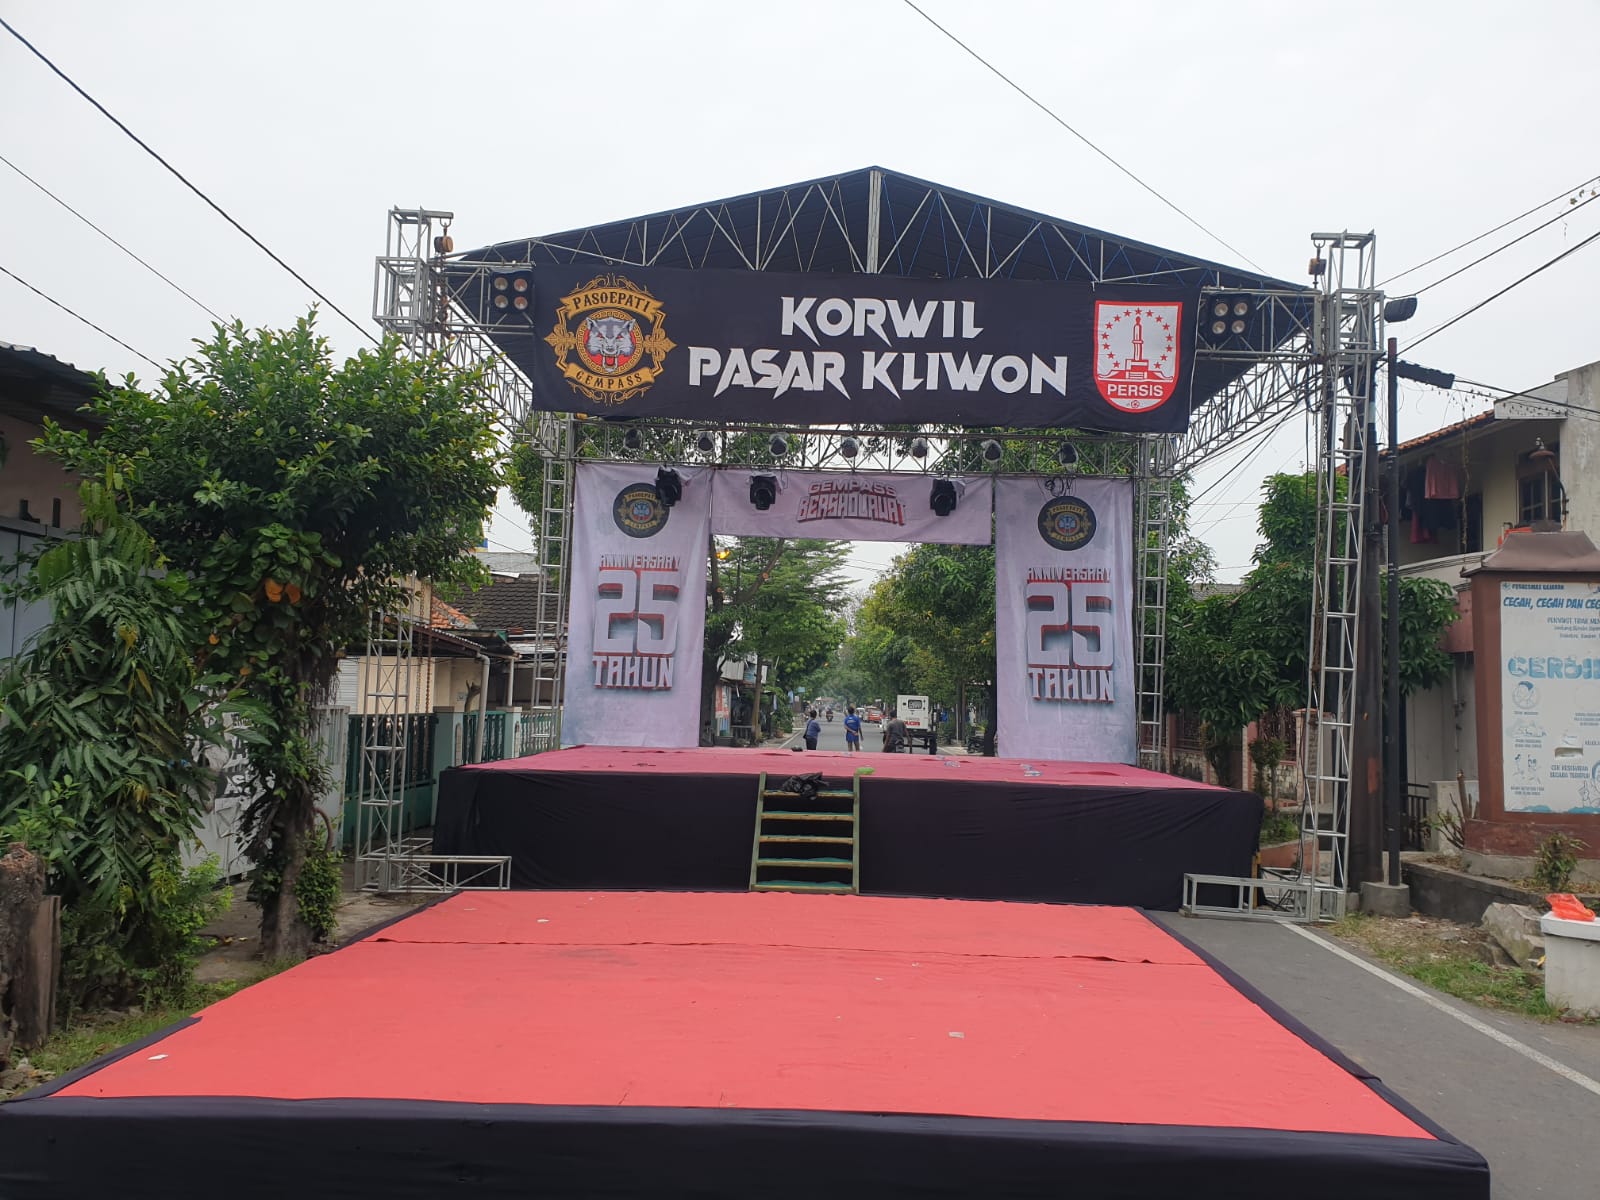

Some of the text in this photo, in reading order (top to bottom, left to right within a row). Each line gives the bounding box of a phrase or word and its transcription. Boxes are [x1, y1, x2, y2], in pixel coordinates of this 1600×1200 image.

[572, 291, 651, 313] PASOEPATI
[781, 296, 984, 347] KORWIL
[575, 370, 642, 389] GEMPASS
[688, 346, 1068, 400] PASAR KLIWON
[1107, 383, 1164, 397] PERSIS
[808, 479, 897, 498] GEMPASS
[599, 553, 681, 571] ANNIVERSARY
[1027, 567, 1111, 583] ANNIVERSARY
[593, 569, 680, 656] 25
[1503, 596, 1533, 610] CEGAH,
[1536, 597, 1564, 608] CEGAH
[1566, 598, 1583, 609] DAN
[1026, 581, 1115, 670] 25
[592, 655, 674, 690] TAHUN
[1028, 667, 1115, 703] TAHUN
